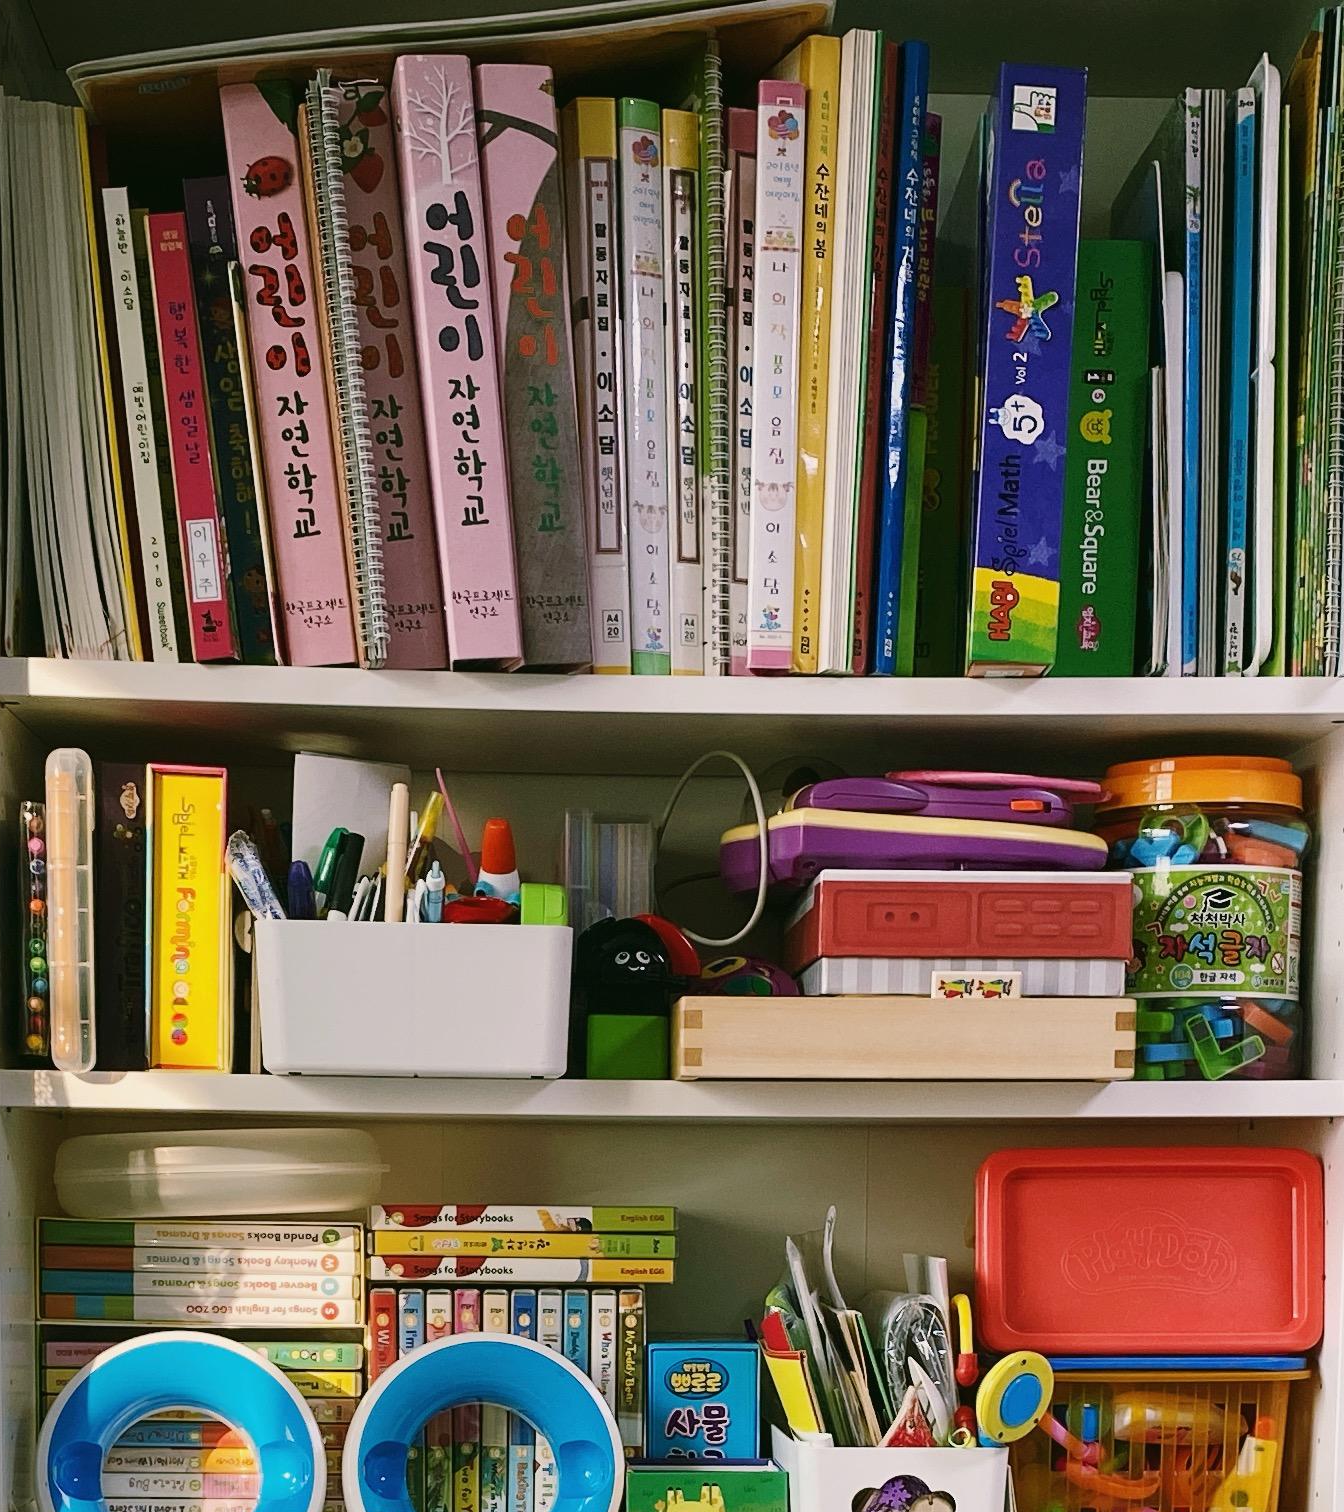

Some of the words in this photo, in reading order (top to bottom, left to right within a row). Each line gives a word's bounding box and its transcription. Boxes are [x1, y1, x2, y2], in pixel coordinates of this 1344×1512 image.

[814, 163, 831, 234] 수잔네의
[903, 168, 920, 239] 수잔네의
[812, 238, 827, 260] 봄
[424, 190, 484, 361] 어린이
[504, 202, 559, 366] 어린이
[249, 211, 311, 377] 어린이
[350, 211, 404, 378] 어린이
[168, 301, 190, 375] 행복한
[1012, 351, 1028, 363] 2
[277, 390, 322, 539] 자연학교
[372, 393, 415, 543] 자연학교
[448, 374, 490, 527] 자연학교
[527, 382, 566, 533] 자연학교
[1079, 458, 1108, 596] Bear&Square
[304, 615, 334, 628] 연구소
[469, 606, 500, 618] 연구소
[606, 613, 620, 623] A4
[684, 617, 696, 627] A4
[606, 626, 620, 637] 20
[684, 630, 696, 640] 20
[1190, 913, 1246, 927] 척척박사
[1158, 930, 1271, 966] 자석글자
[414, 1213, 442, 1224] Songs
[444, 1213, 457, 1222] for
[459, 1213, 514, 1224] Storybooks
[247, 1232, 281, 1243] Books
[283, 1232, 319, 1243] Panda
[414, 1265, 442, 1276] Songs
[444, 1265, 457, 1274] for
[459, 1265, 514, 1276] Storybooks
[665, 1404, 730, 1443] 사물
